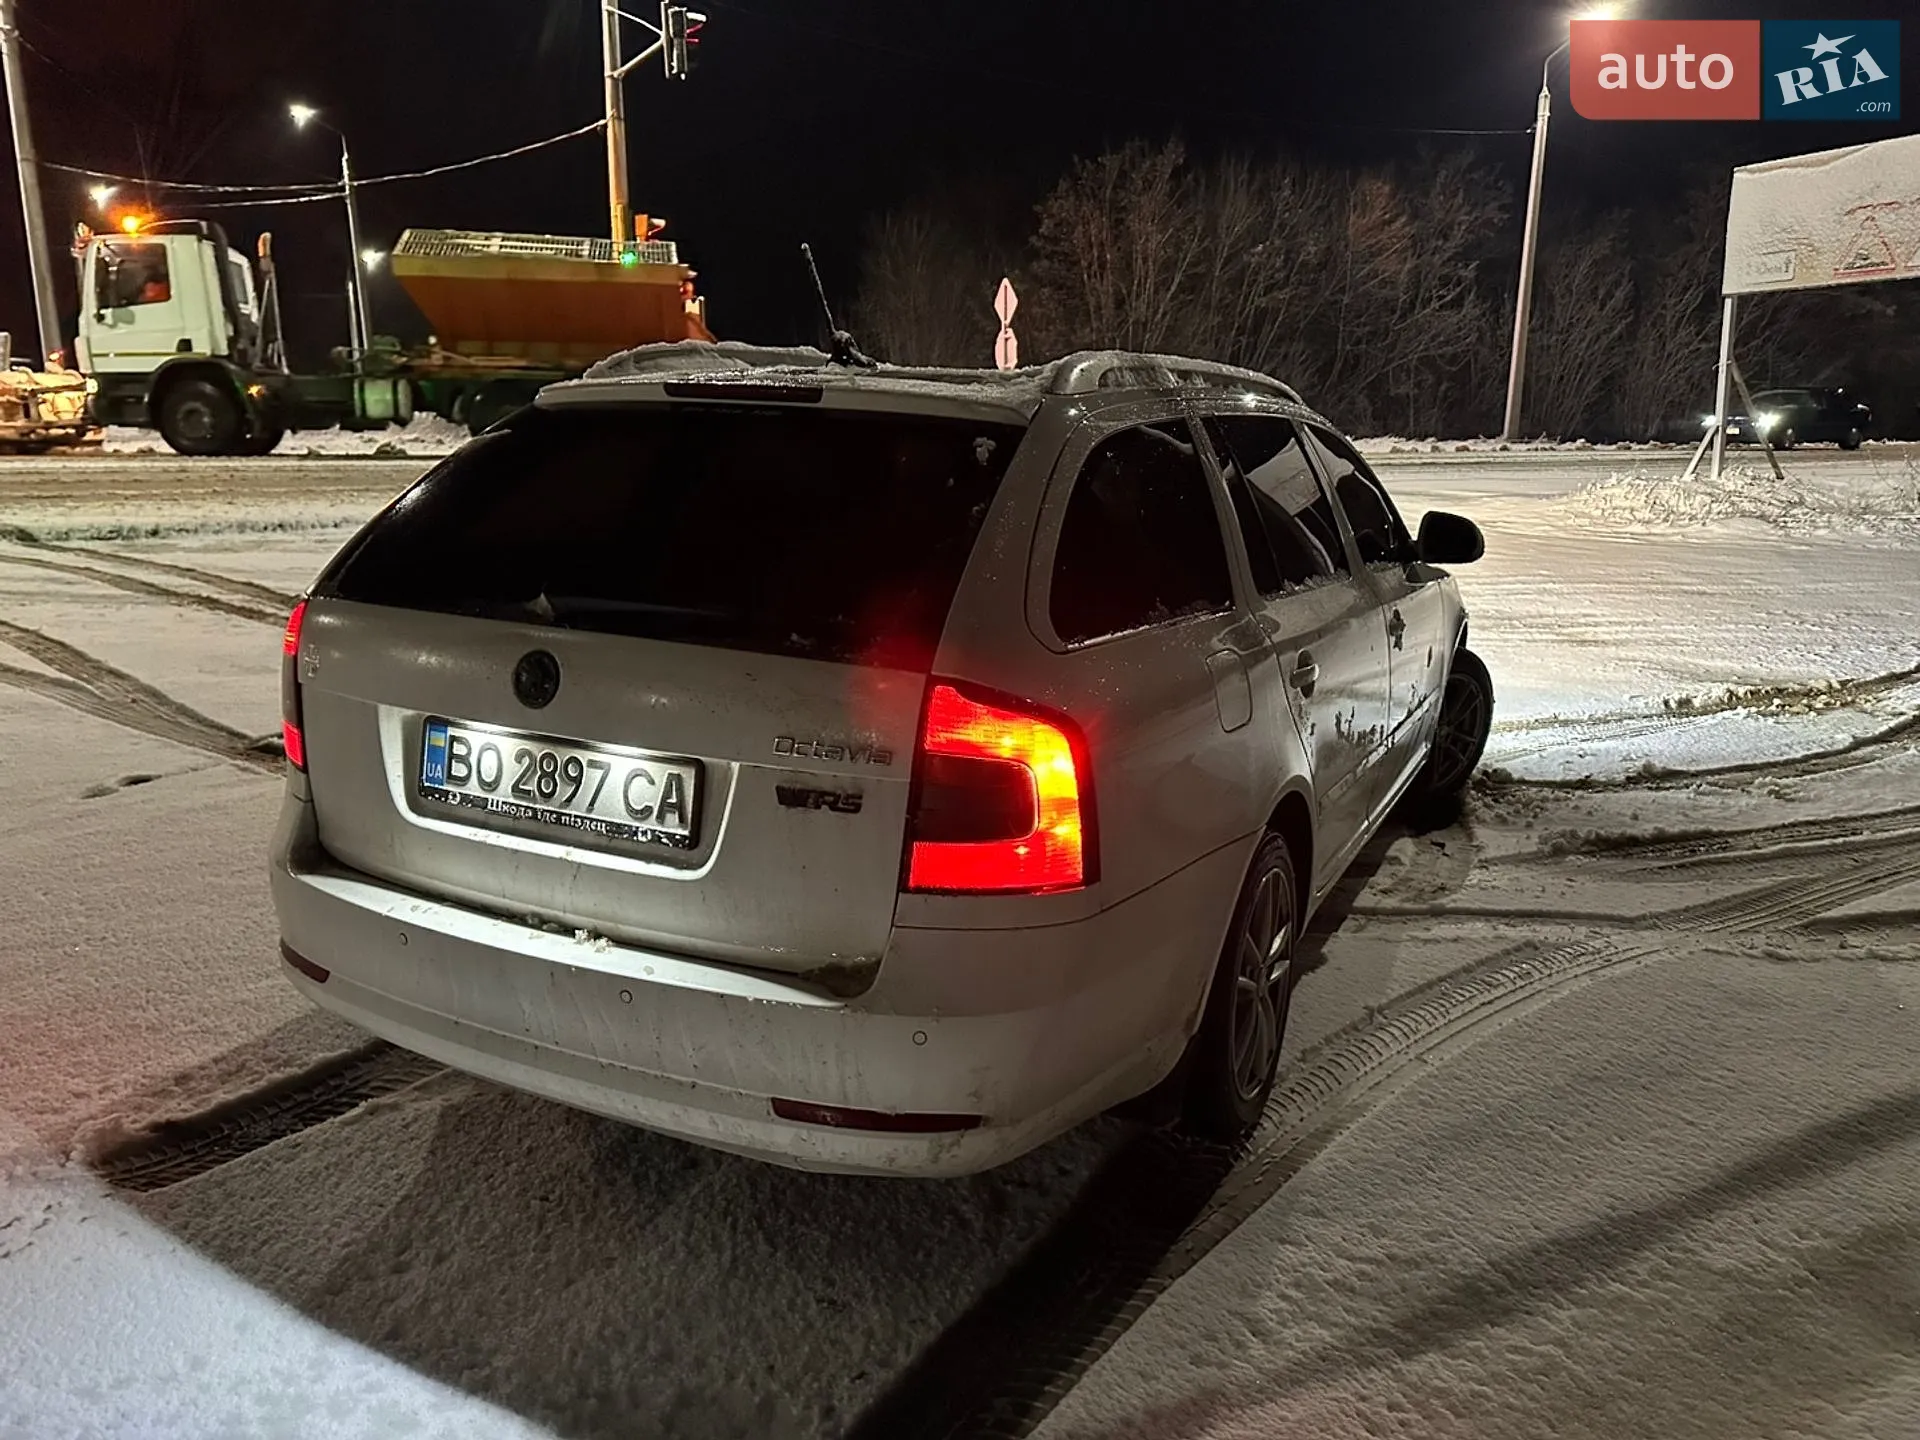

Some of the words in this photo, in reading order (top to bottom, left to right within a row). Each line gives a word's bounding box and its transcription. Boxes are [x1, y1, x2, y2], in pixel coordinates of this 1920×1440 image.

[773, 736, 893, 766] Octavia
[427, 762, 443, 779] UA
[447, 734, 504, 793] BO
[511, 747, 611, 814] 2897
[622, 767, 687, 825] CA
[487, 798, 533, 819] Шкода
